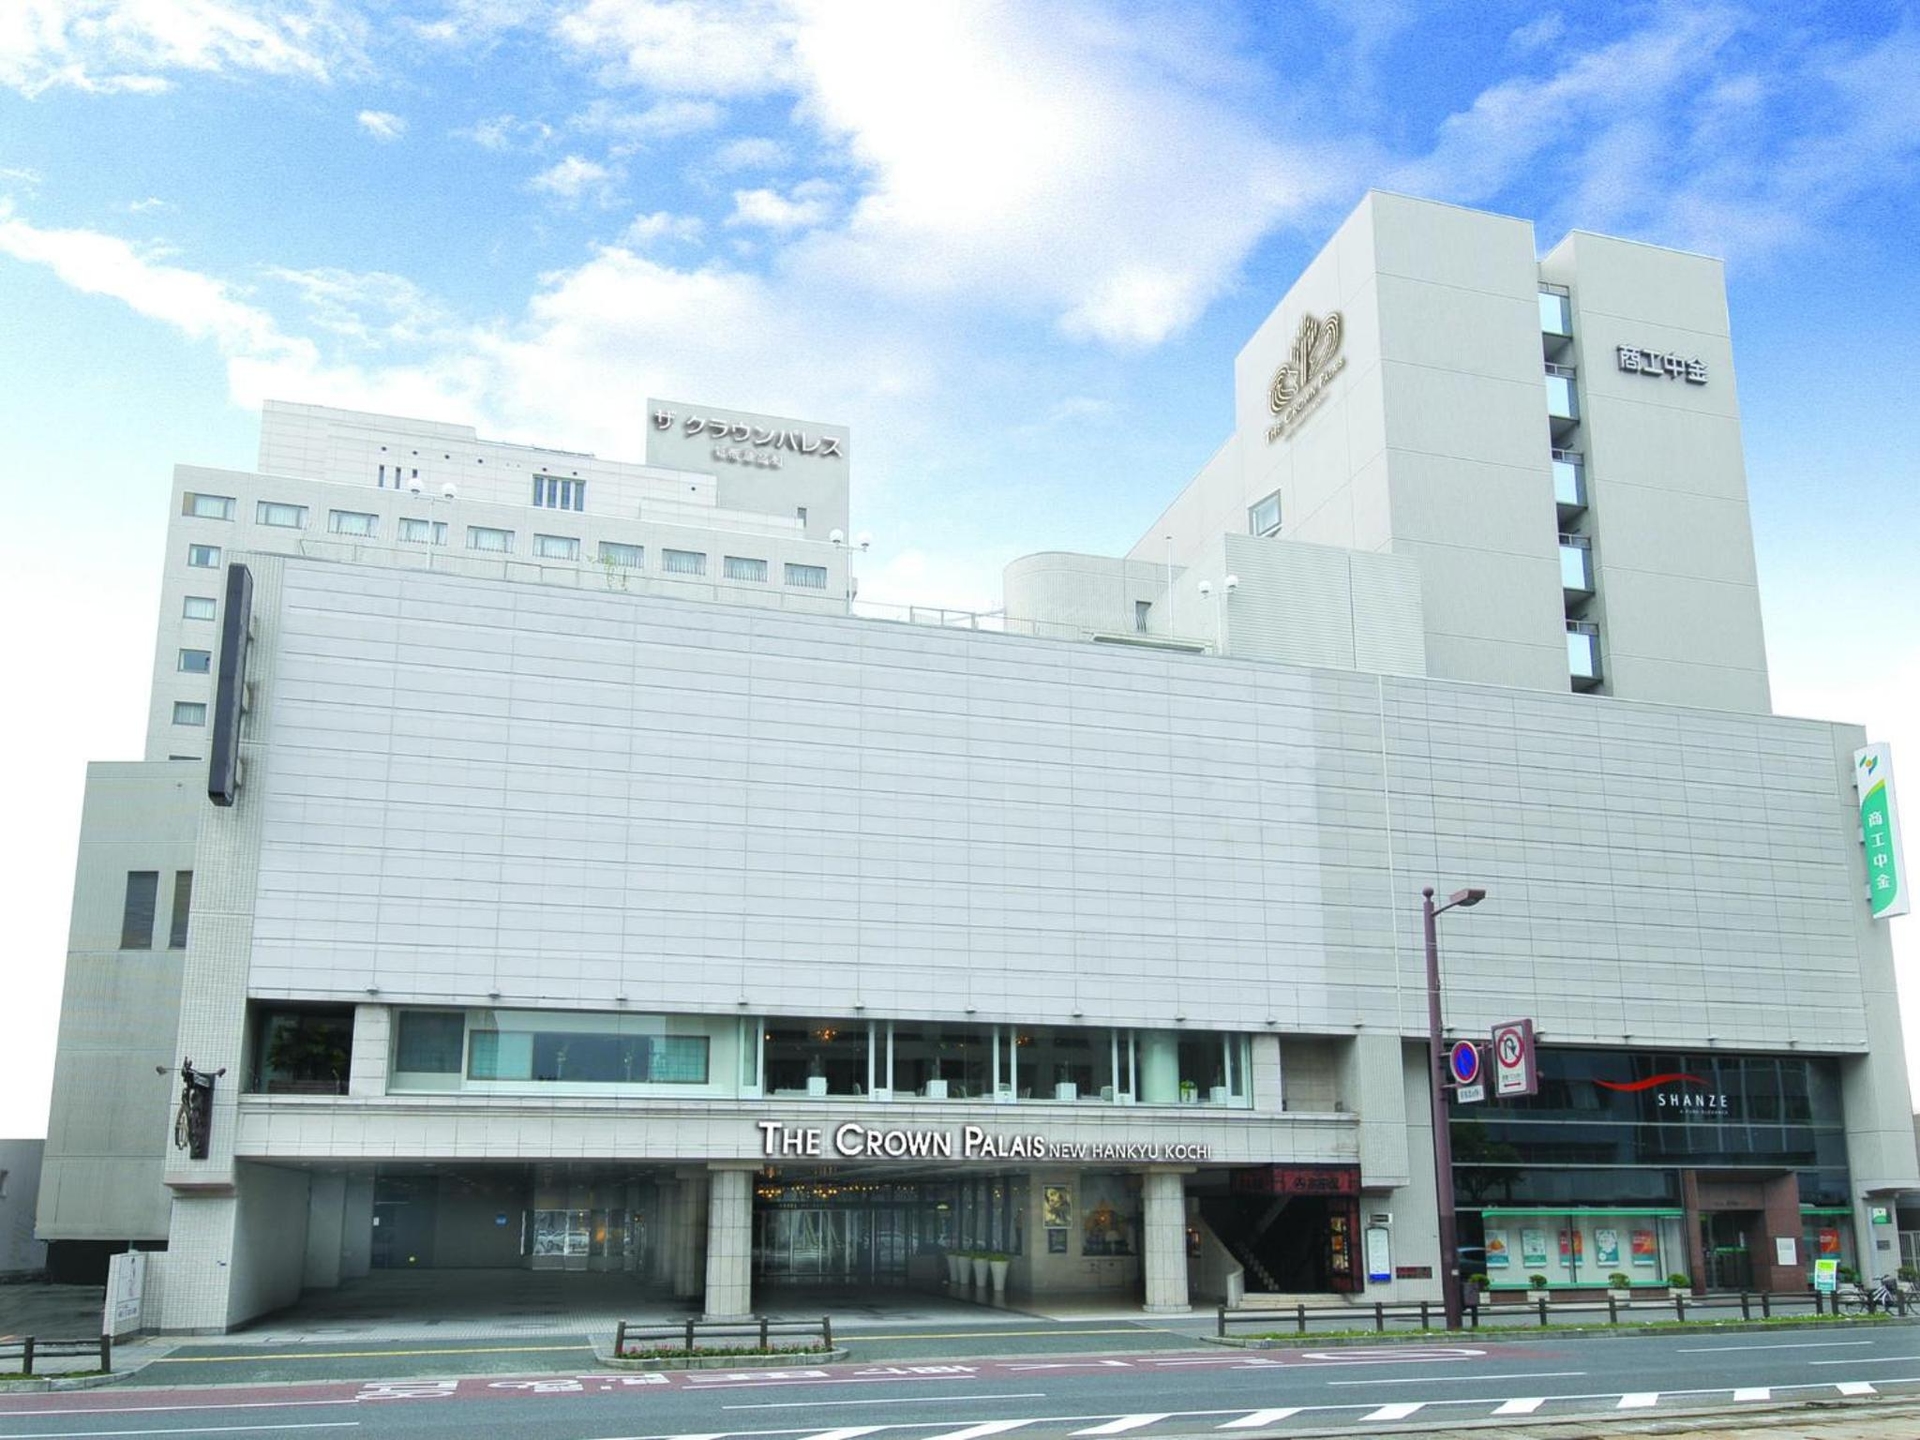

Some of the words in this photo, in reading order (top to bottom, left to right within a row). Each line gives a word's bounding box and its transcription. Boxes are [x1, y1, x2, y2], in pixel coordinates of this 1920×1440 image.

[1617, 344, 1708, 385] 商工中金
[654, 408, 677, 431] ザ
[685, 414, 843, 458] クラウンパレス
[1868, 811, 1891, 889] 商工中金
[1658, 1093, 1728, 1107] SHANZE
[758, 1121, 822, 1155] THE
[835, 1122, 952, 1157] CROWN
[964, 1126, 1045, 1158] PALAIS
[1050, 1143, 1087, 1158] NEW
[1092, 1143, 1159, 1159] HANKYU
[1165, 1144, 1211, 1160] KOCHI
